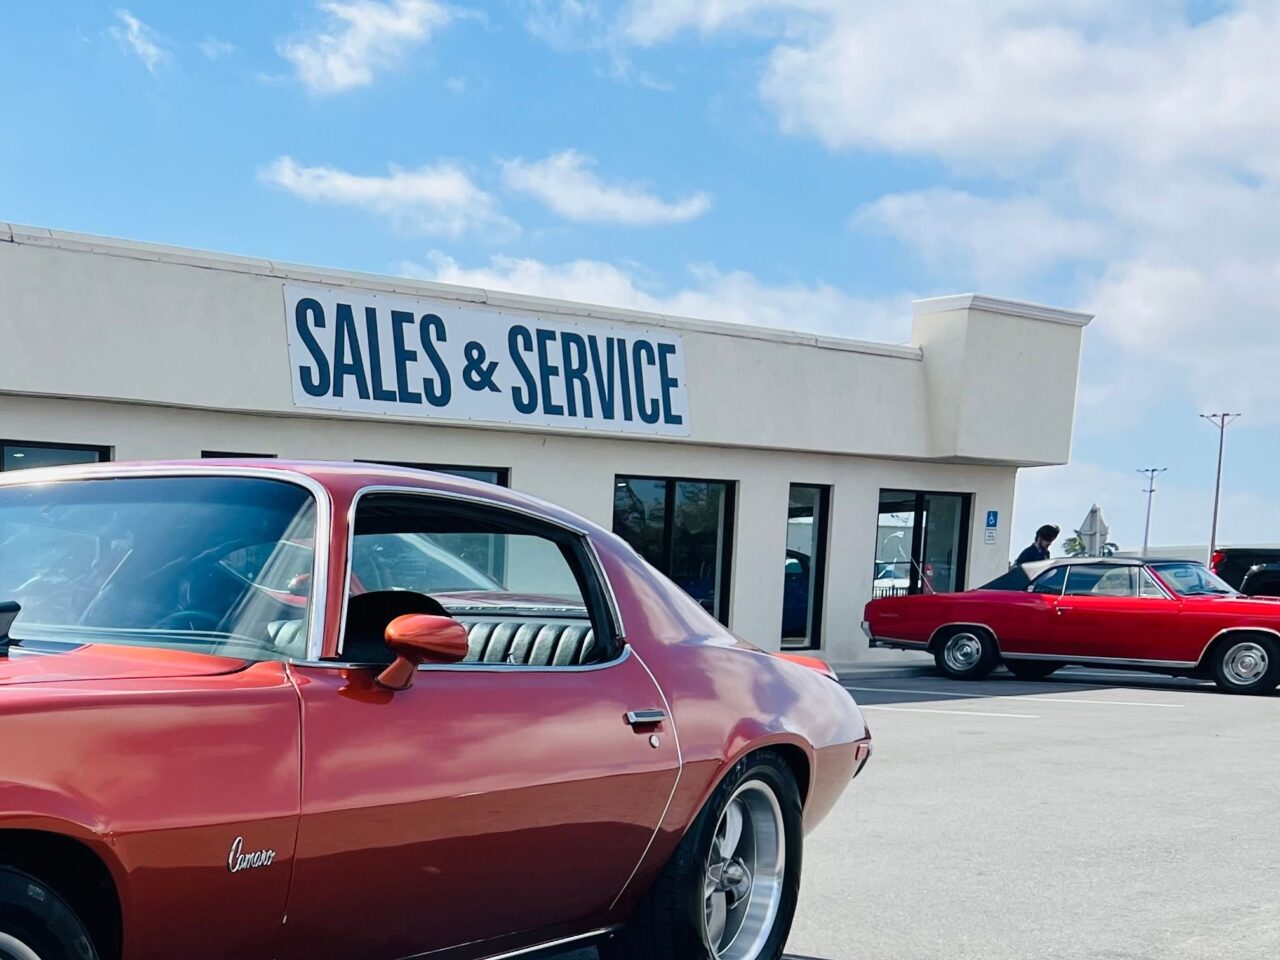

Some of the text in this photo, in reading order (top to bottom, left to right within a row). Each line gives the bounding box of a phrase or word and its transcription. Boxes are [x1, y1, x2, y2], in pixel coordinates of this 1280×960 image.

[295, 297, 683, 426] SALES & SERVICE
[228, 836, 276, 873] Camaro
